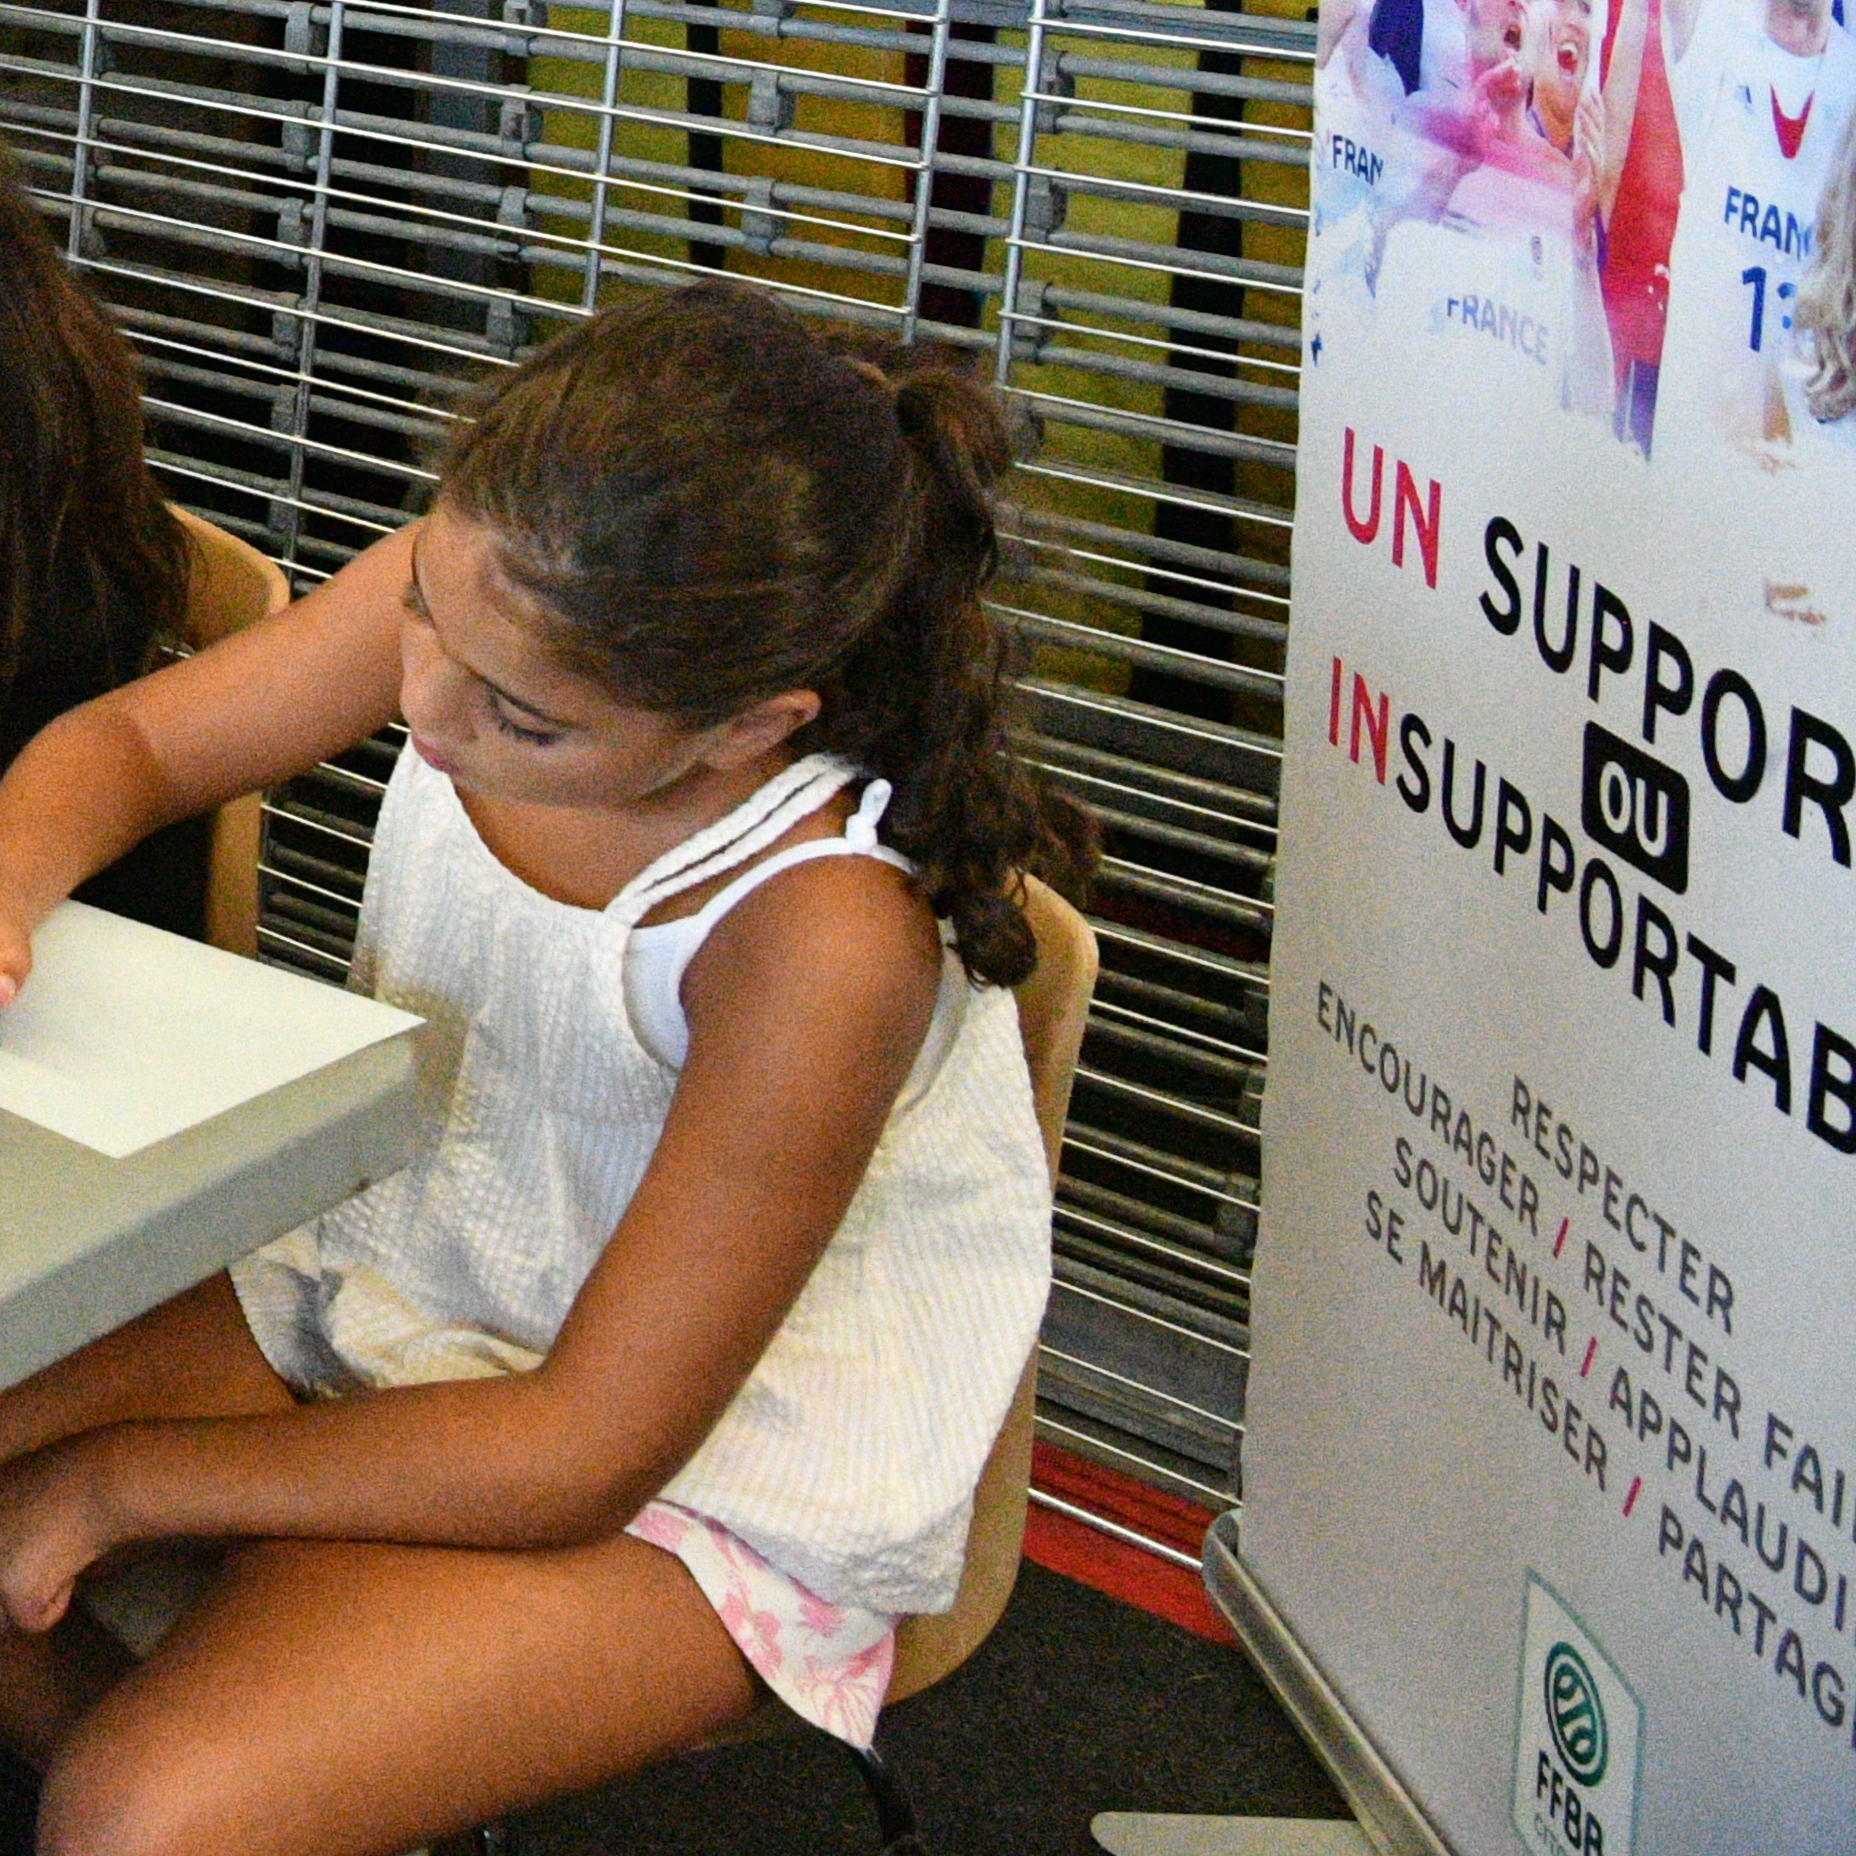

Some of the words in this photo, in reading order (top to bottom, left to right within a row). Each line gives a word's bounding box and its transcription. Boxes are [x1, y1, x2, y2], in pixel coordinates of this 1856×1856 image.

[1341, 426, 1441, 590] UN
[1478, 515, 1856, 870] SUPPOR
[1599, 760, 1670, 859] OU
[1317, 980, 1539, 1237] ENCOURAGER
[1585, 1240, 1742, 1441] RESTER
[1764, 1412, 1856, 1544] FAI
[1393, 1136, 1566, 1356] SOUTENIR
[1511, 1074, 1734, 1336] RESPECTER
[1365, 1190, 1405, 1265] SE
[1419, 1240, 1607, 1492] MAITRISER
[1659, 1503, 1856, 1749] PARTAG
